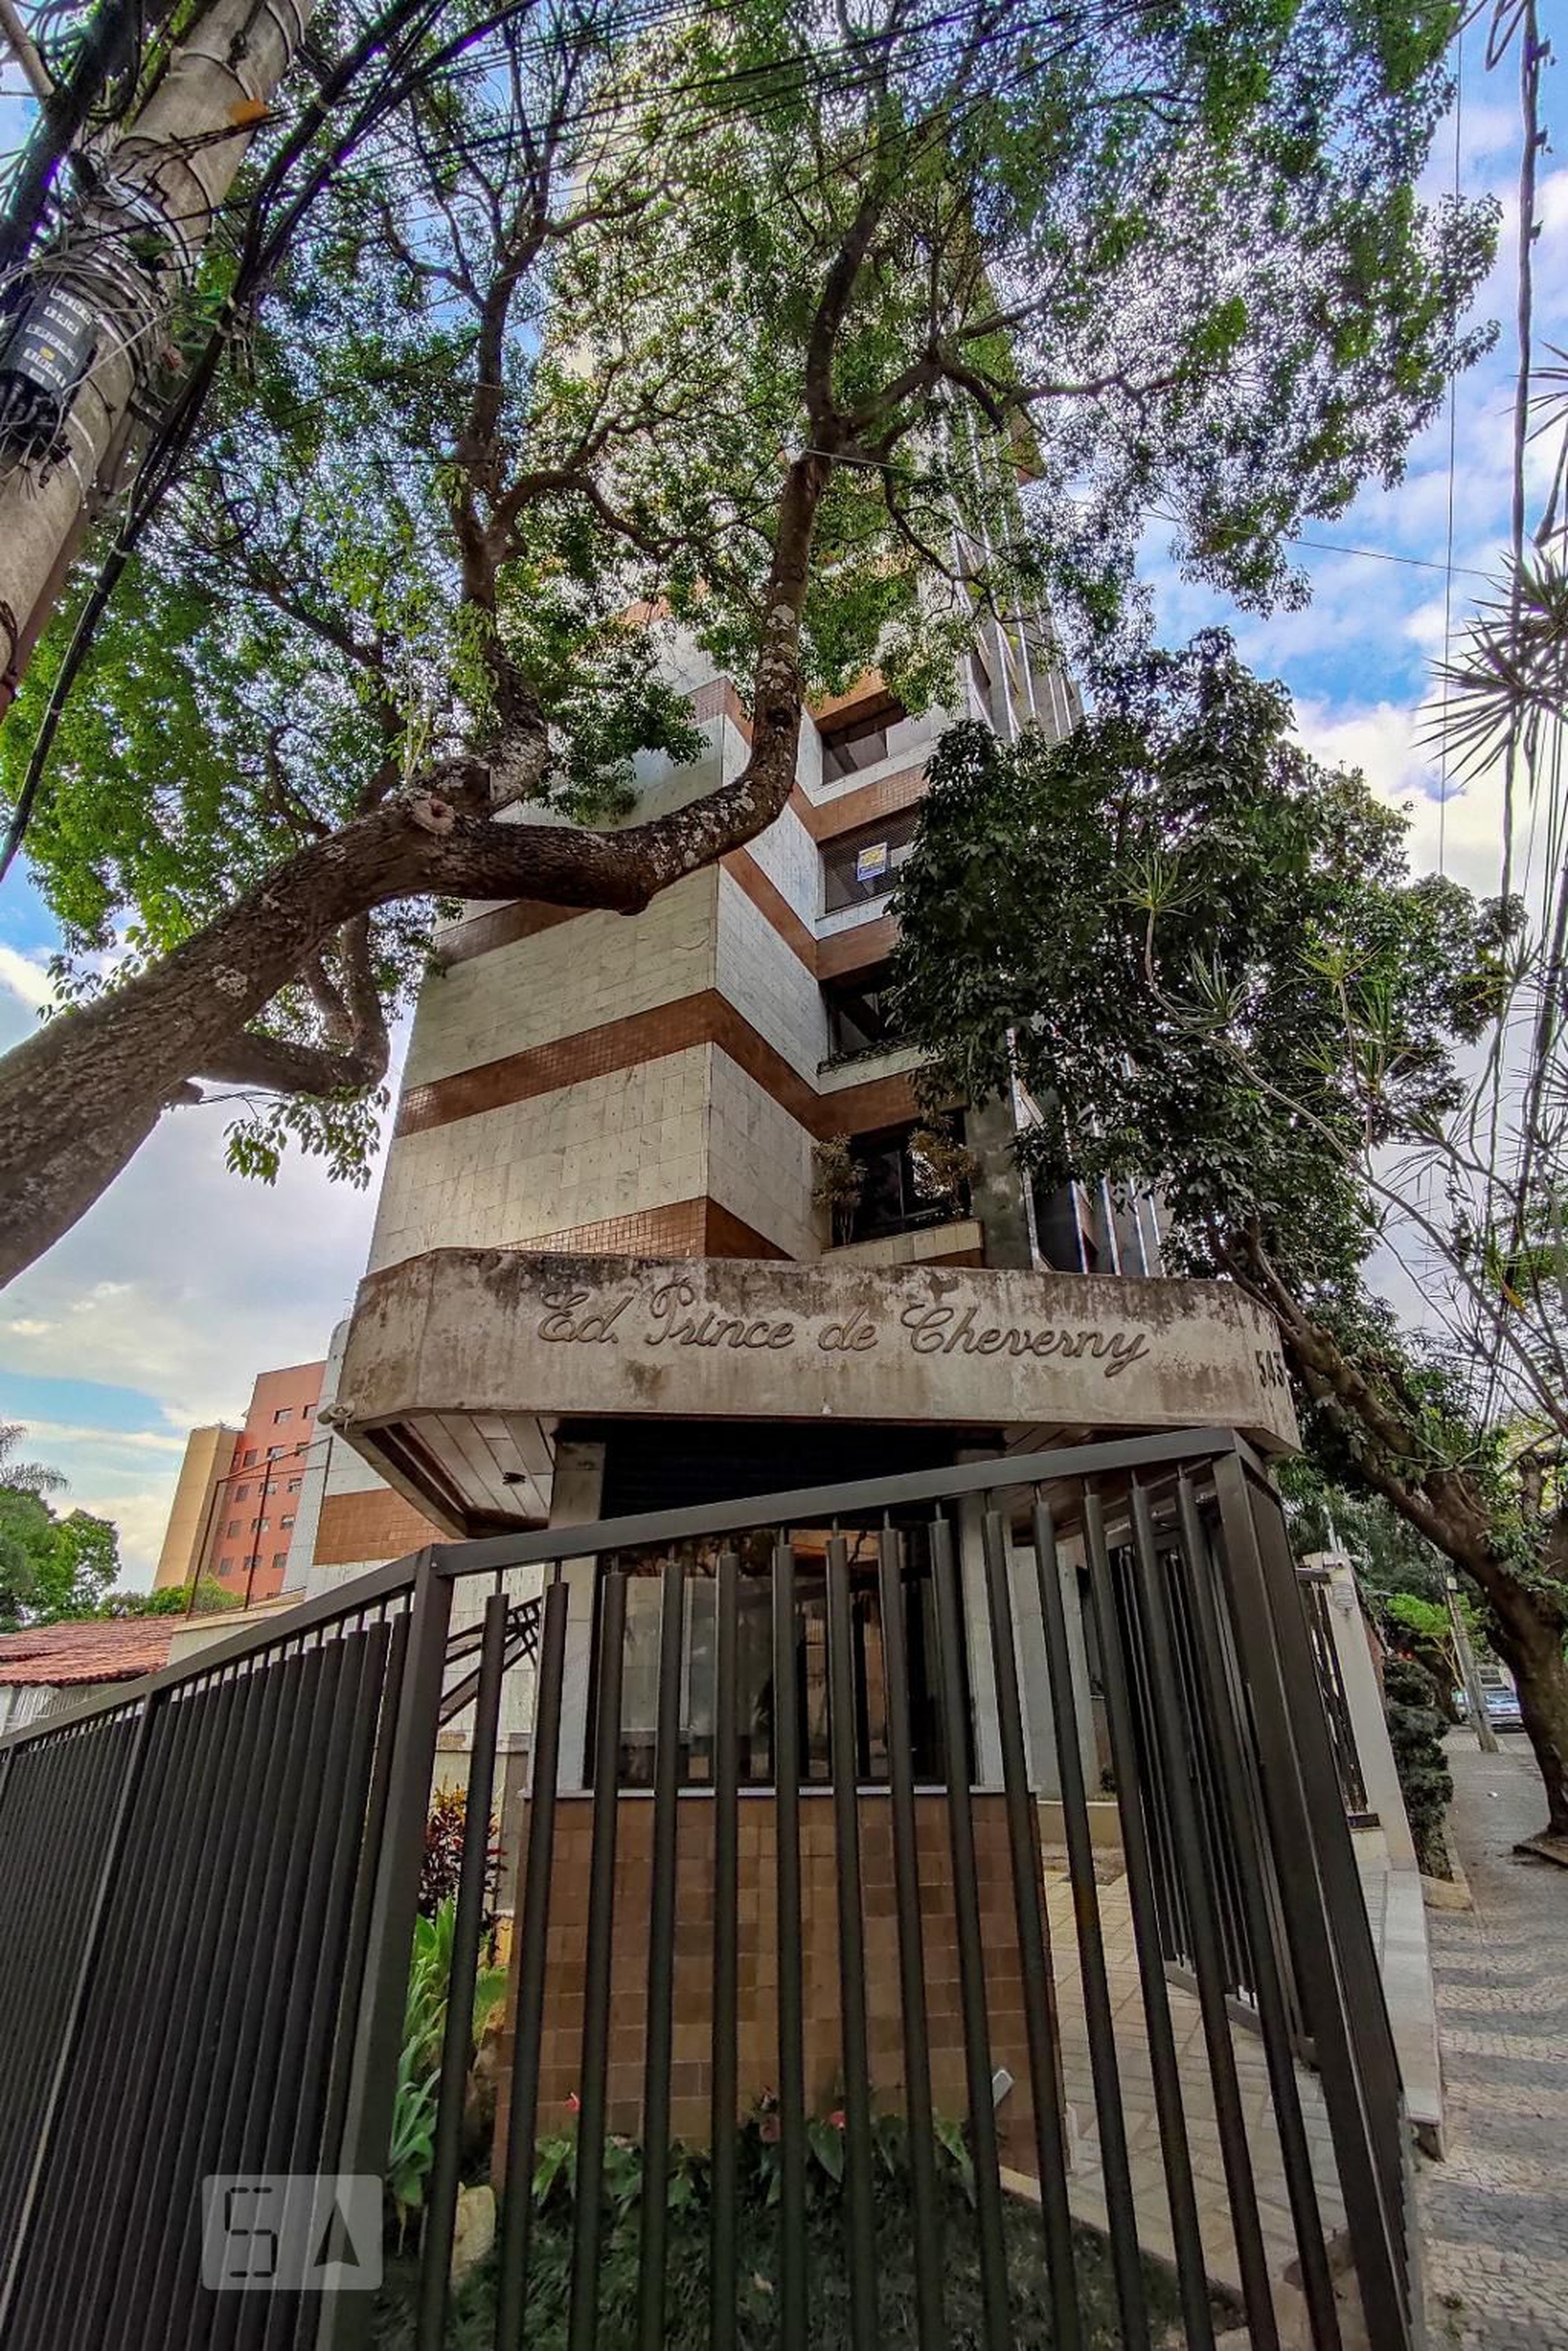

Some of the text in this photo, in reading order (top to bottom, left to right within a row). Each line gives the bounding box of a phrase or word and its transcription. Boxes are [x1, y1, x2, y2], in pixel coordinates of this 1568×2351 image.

[537, 1274, 1150, 1378] Ed. Prince de Cheverny
